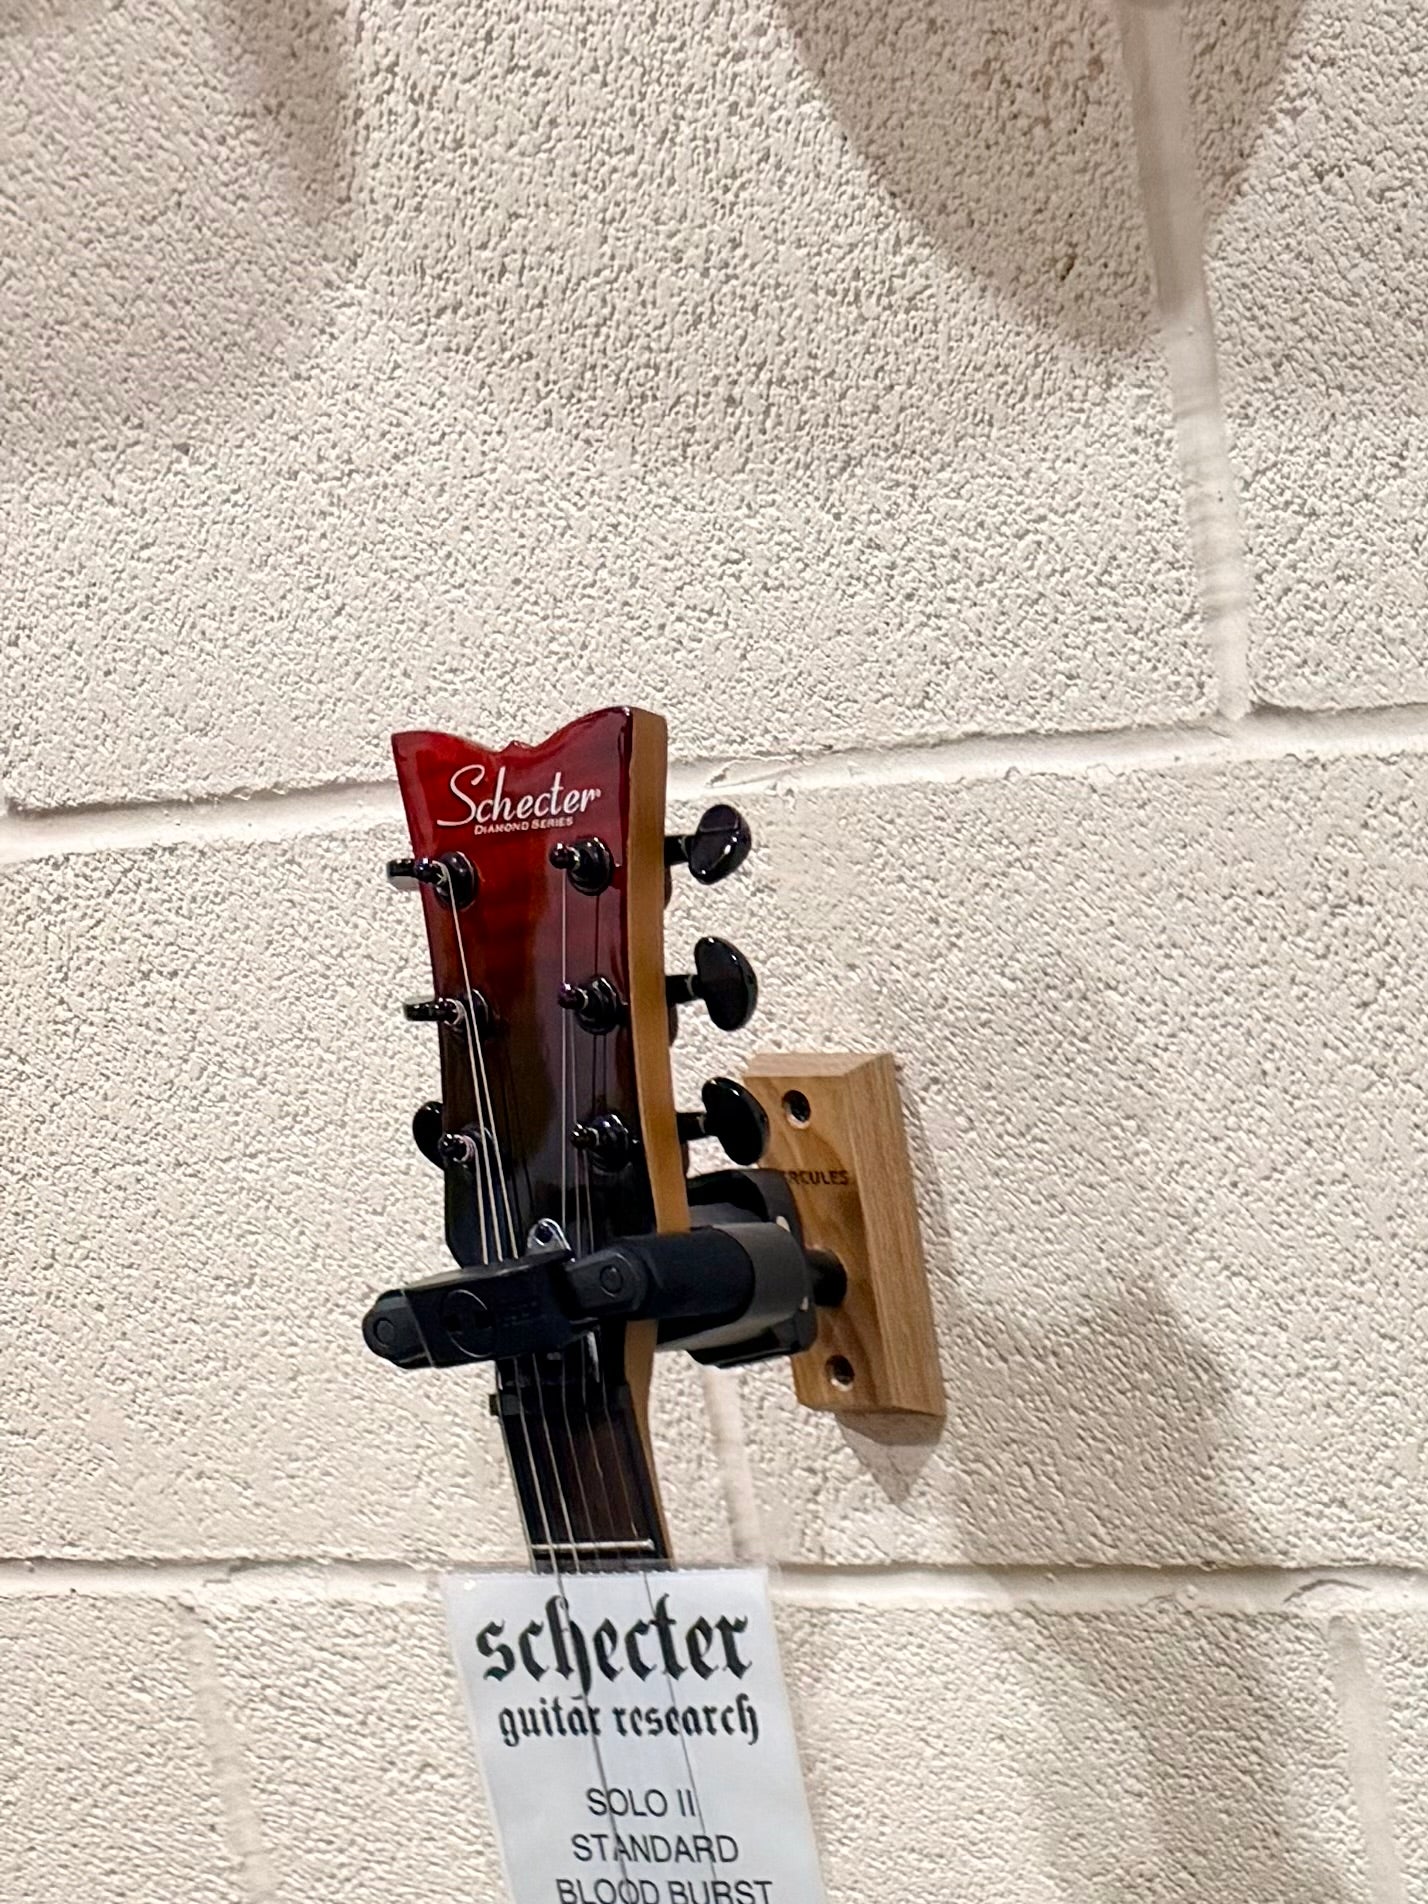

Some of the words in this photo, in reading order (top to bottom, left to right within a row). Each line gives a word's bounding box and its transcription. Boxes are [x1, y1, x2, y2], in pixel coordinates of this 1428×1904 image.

[436, 764, 602, 827] Schecter
[787, 1169, 849, 1185] RCULES
[475, 1593, 752, 1698] schecter
[498, 1696, 602, 1747] guitar
[611, 1693, 760, 1746] research
[585, 1787, 669, 1817] SOLO
[571, 1833, 739, 1863] STANDARD
